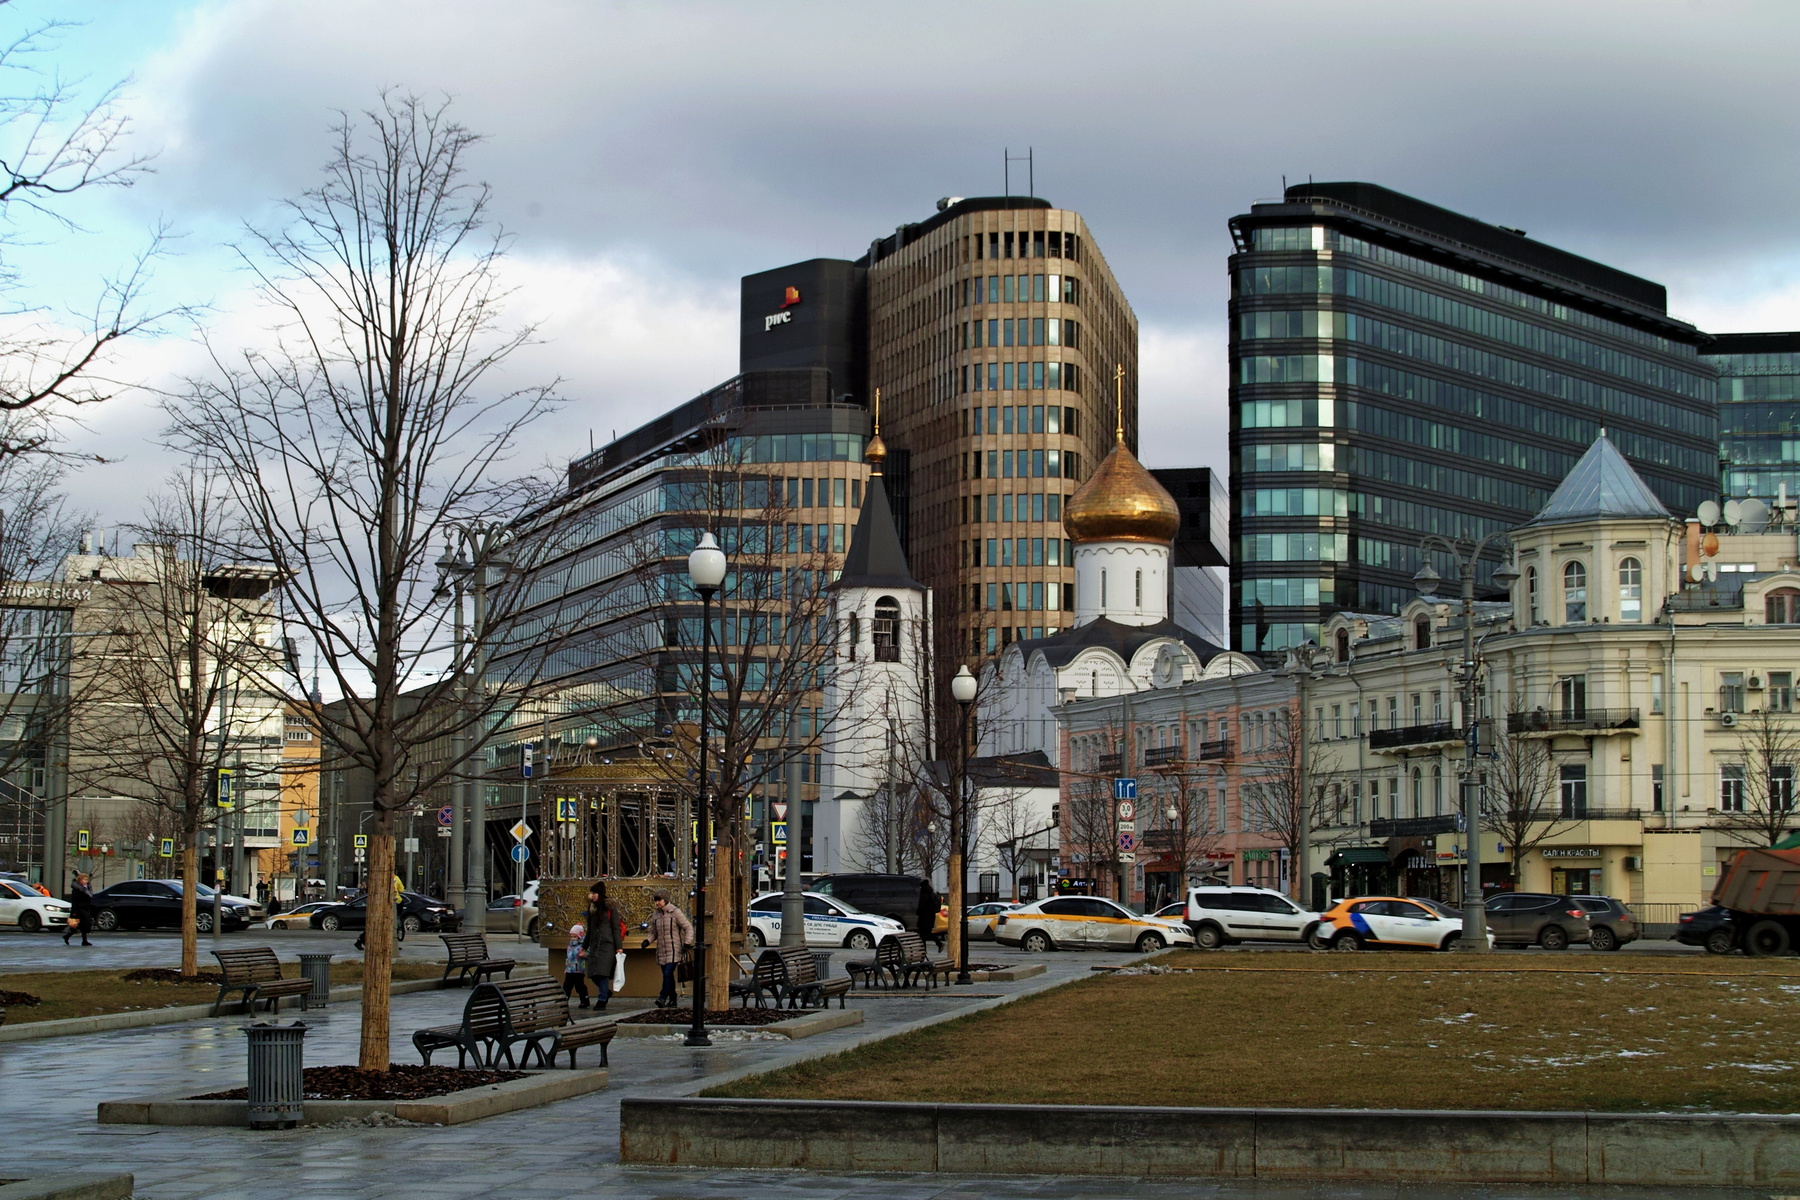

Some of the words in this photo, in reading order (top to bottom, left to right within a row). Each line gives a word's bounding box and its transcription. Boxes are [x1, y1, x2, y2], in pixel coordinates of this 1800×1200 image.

[765, 311, 791, 331] pwc
[1543, 849, 1565, 857] САЛОН
[1567, 849, 1599, 857] КРАСОТЫ
